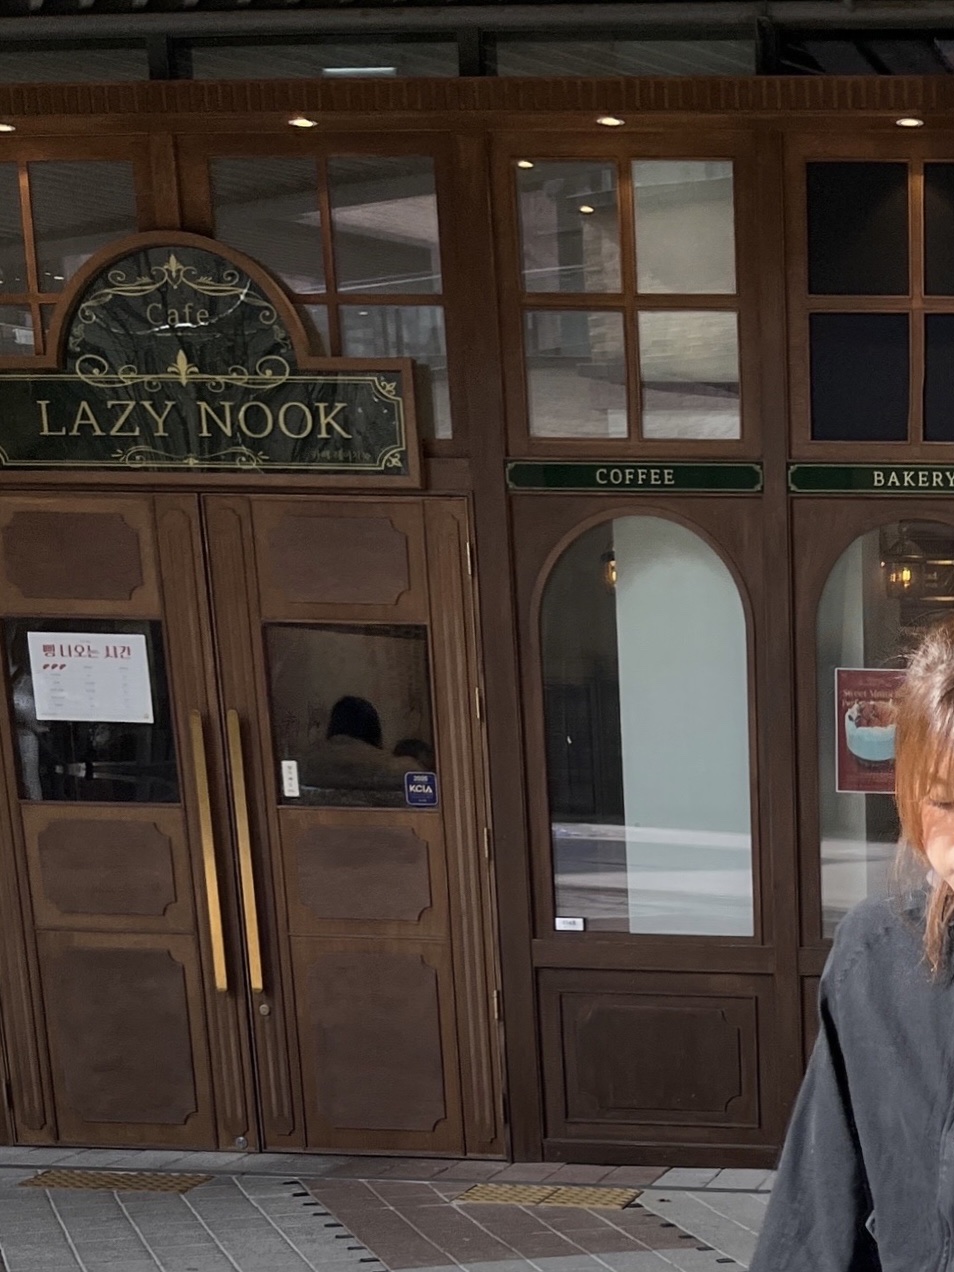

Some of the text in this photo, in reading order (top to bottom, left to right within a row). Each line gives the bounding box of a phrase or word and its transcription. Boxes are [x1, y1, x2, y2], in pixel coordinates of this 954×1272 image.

[146, 303, 210, 325] Cafe
[37, 401, 353, 439] LAZY NOOK
[595, 468, 675, 485] COFFEE
[104, 645, 131, 660] 시간
[409, 784, 433, 794] KCIA
